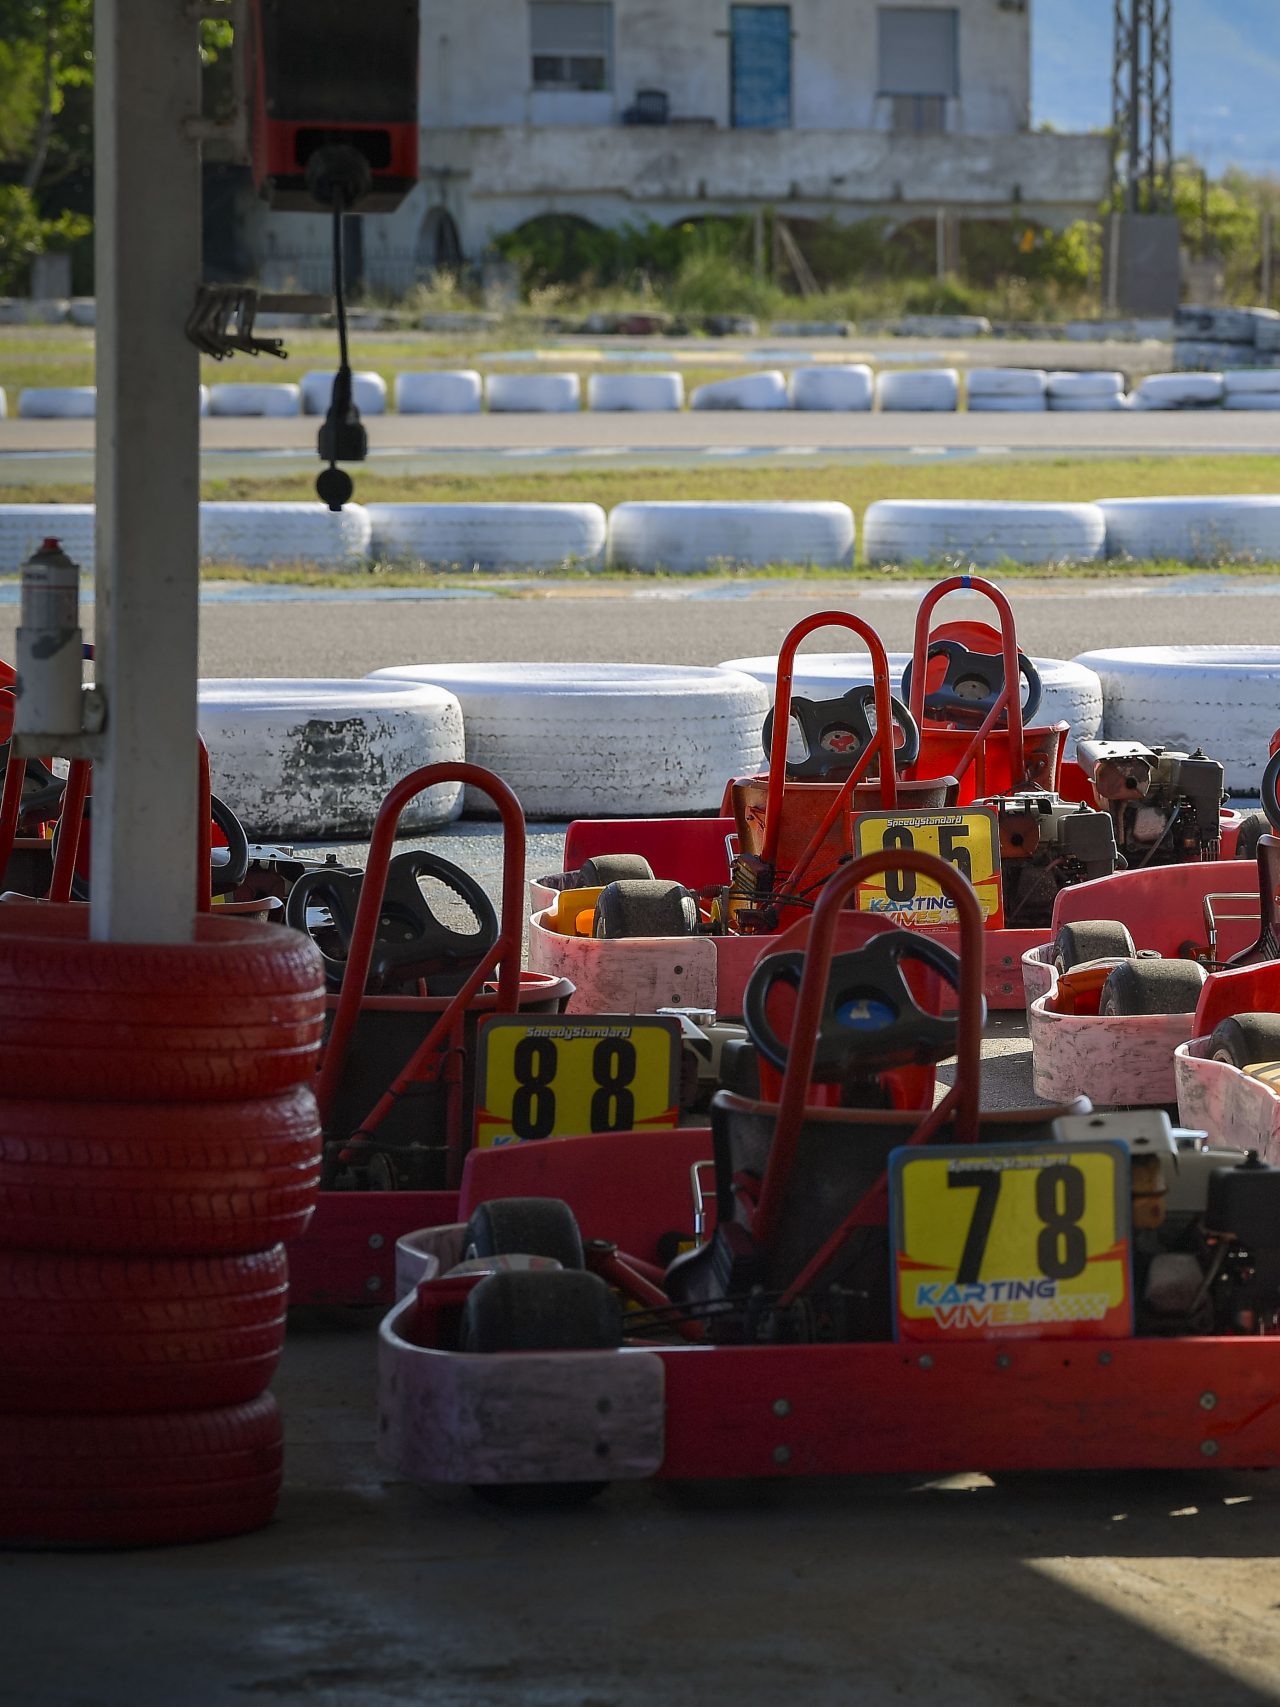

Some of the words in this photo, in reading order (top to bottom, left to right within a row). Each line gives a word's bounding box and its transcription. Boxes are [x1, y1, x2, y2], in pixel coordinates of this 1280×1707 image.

[526, 1027, 632, 1040] SpeedyStandard
[511, 1037, 636, 1139] 88
[947, 1162, 1087, 1285] 78
[917, 1279, 1057, 1307] KARTING
